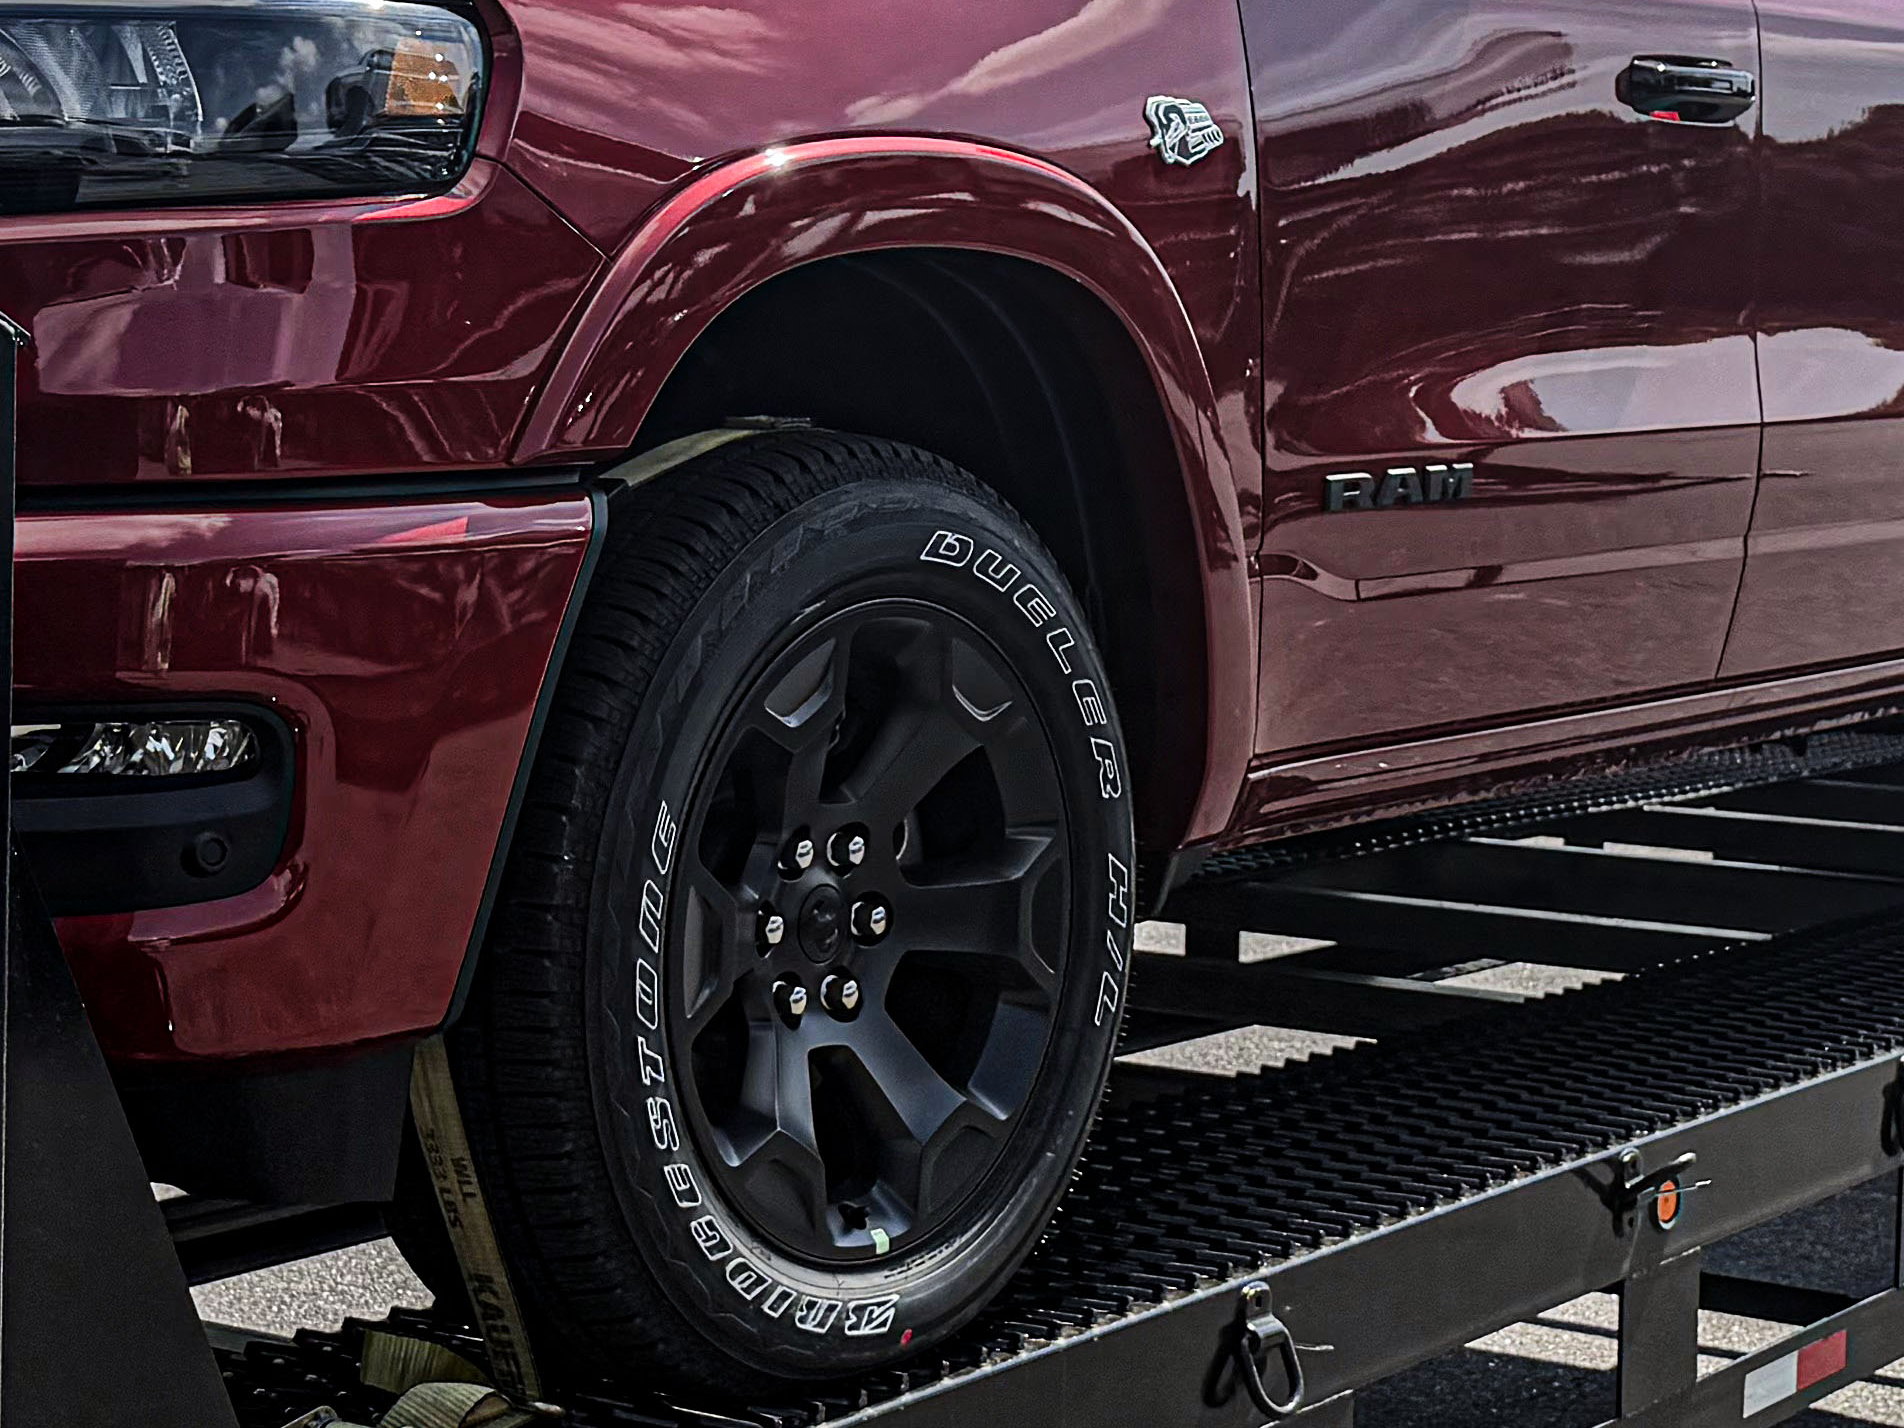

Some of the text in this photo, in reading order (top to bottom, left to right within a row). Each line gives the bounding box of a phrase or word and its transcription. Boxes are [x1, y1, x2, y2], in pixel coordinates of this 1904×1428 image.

[1325, 462, 1474, 511] RAM
[918, 529, 1122, 802] DUELER
[1092, 853, 1132, 1028] H/L
[634, 800, 901, 1339] BRIDGESTONE
